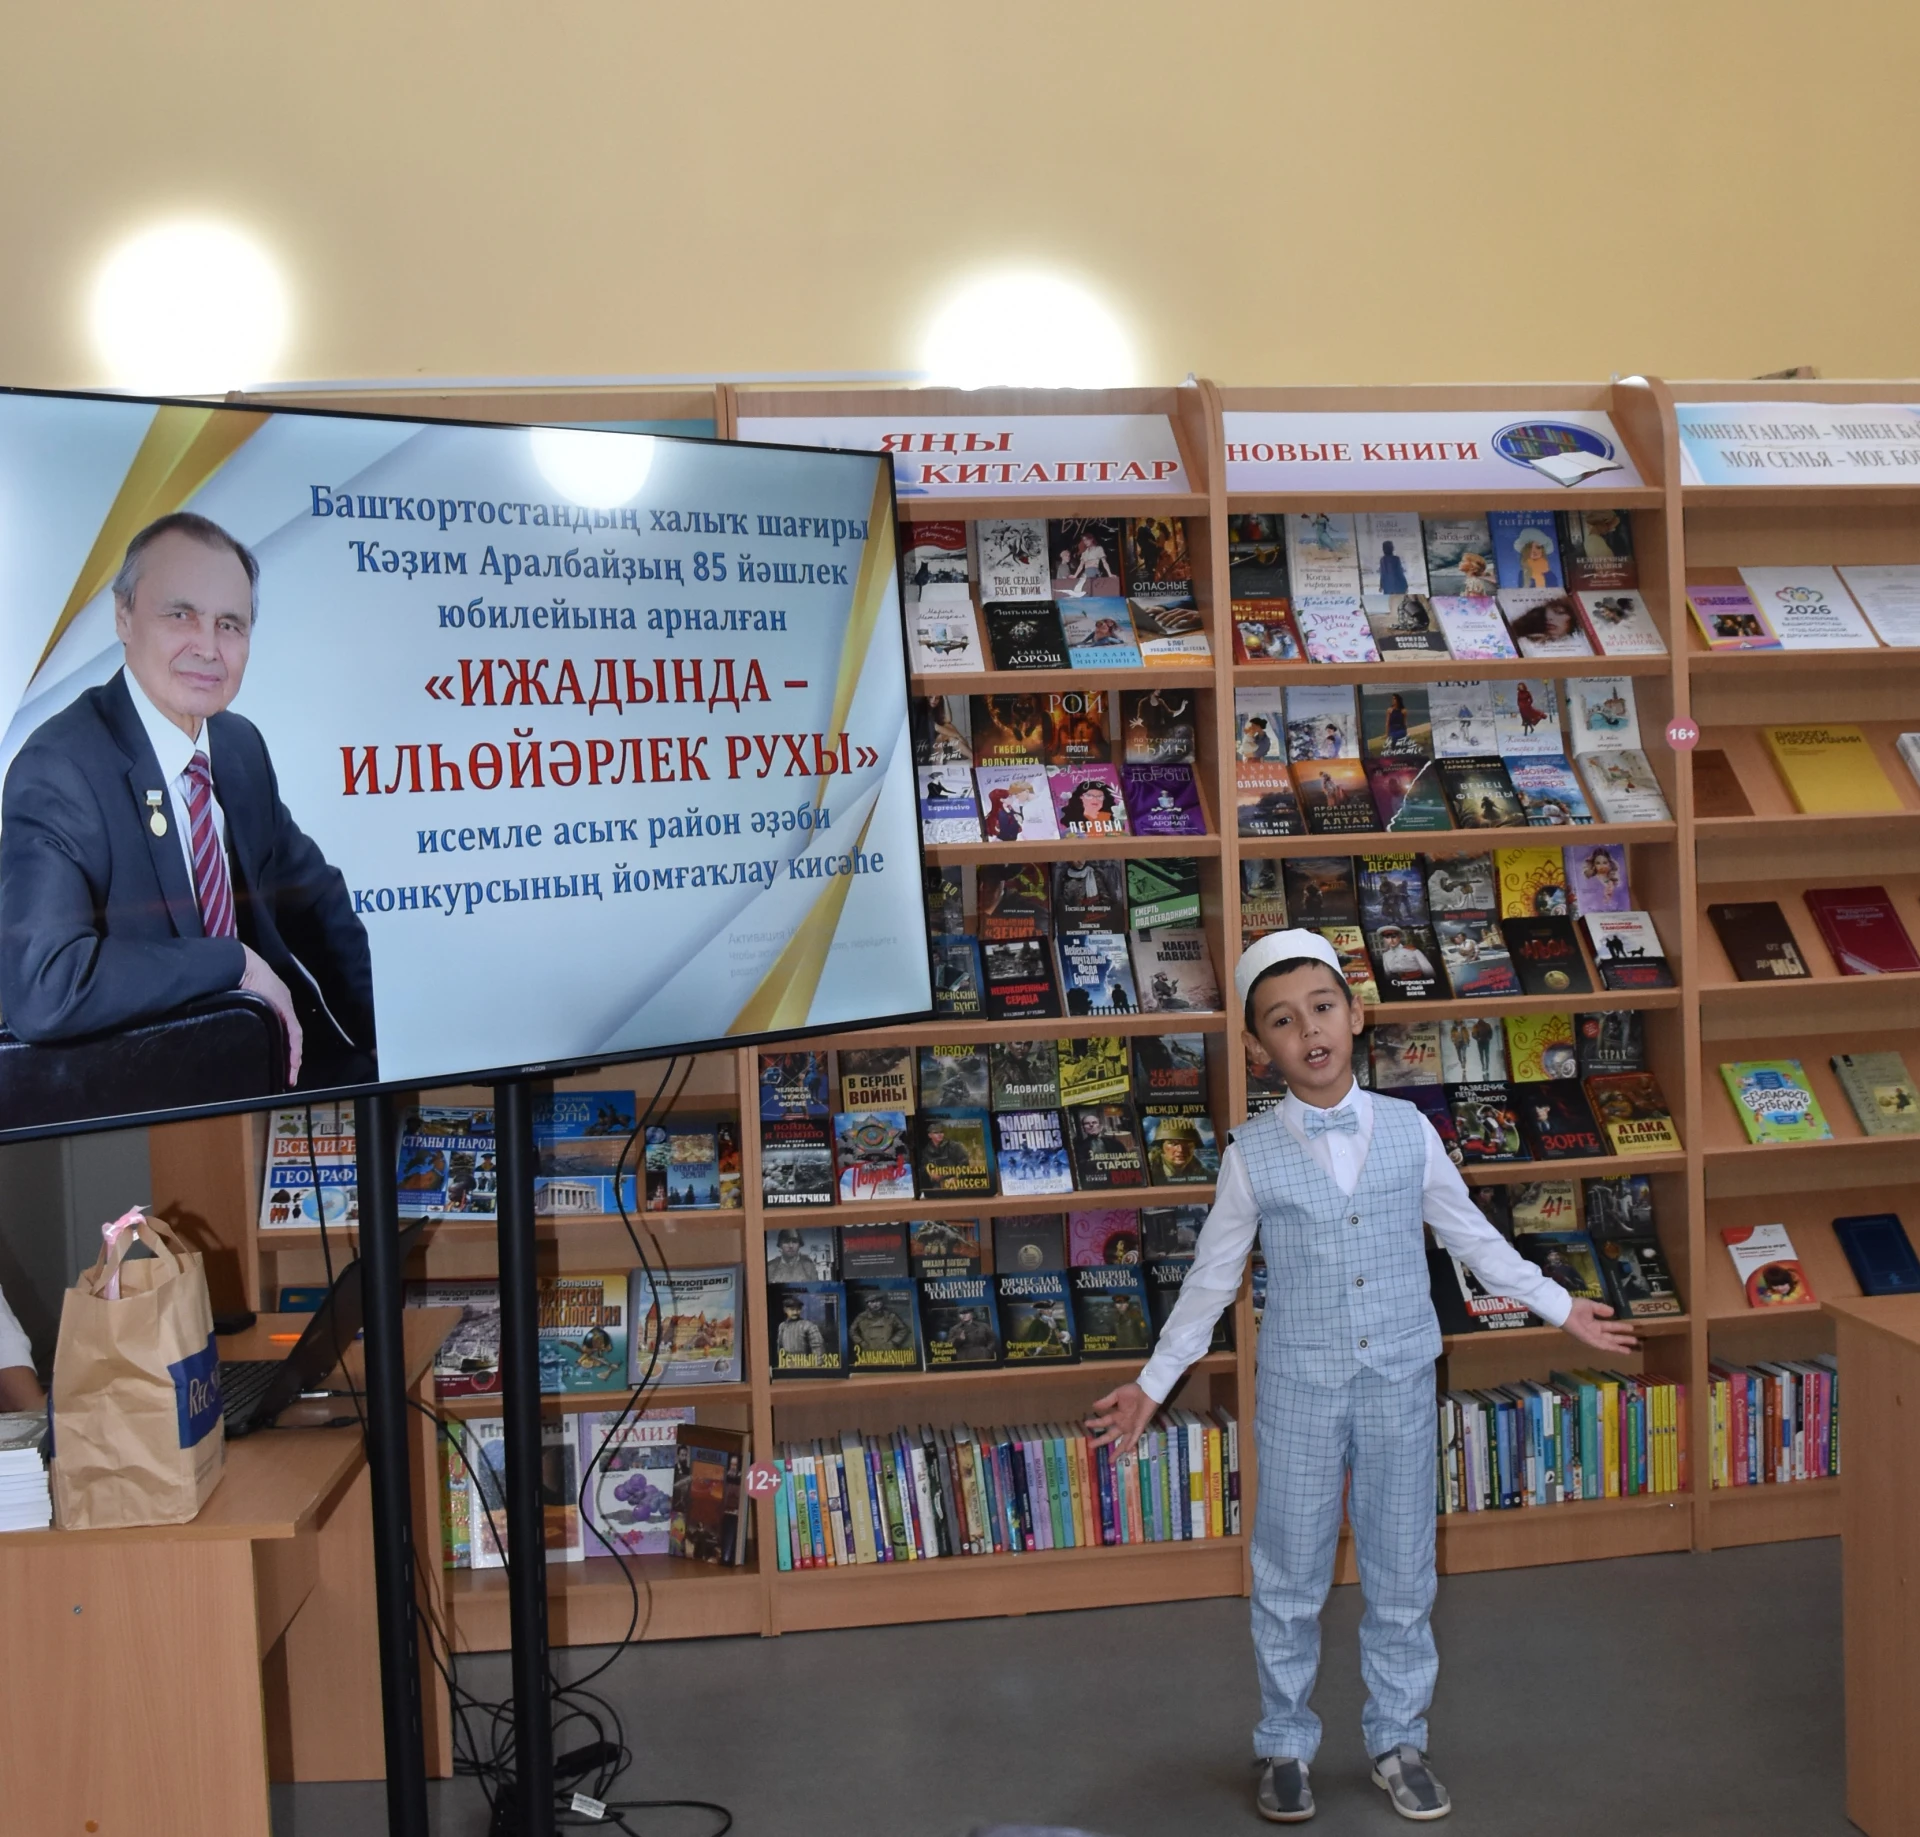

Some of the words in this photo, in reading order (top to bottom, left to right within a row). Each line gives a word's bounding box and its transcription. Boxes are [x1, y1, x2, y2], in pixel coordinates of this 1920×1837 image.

[879, 433, 1014, 455] ЯҢЫ
[1225, 444, 1351, 462] НОВЫЕ
[1363, 443, 1480, 461] КНИГИ
[1721, 451, 1764, 468] МОЯ
[1767, 452, 1834, 468] СЕМЬЯ
[1846, 451, 1892, 467] МОЕ
[919, 461, 1178, 484] КИТАПТАР
[310, 485, 640, 535] Башҡортостандың
[650, 509, 748, 537] халыҡ
[758, 512, 869, 545] шағиры
[350, 541, 468, 579] Ҡәҙим
[480, 544, 684, 586] Аралбайҙың
[694, 552, 727, 582] 85
[738, 557, 848, 586] йәшлек
[994, 576, 1011, 585] ТВОЕ
[1133, 581, 1188, 591] ОПАСНЫЕ
[995, 586, 1017, 596] БУДЕТ
[1784, 605, 1831, 614] 2026
[438, 598, 636, 631] юбилейына
[647, 605, 787, 637] арналған
[1008, 654, 1061, 665] ДОРОШ
[425, 659, 771, 716] «ИЖАДЫНДА
[1049, 690, 1104, 714] РОЙ
[1669, 728, 1696, 740] 16+
[994, 745, 1026, 754] ГИБЕЛЬ
[340, 728, 709, 797] ИЛҺӨЙӘРЛЕК
[728, 733, 878, 780] РУХЫ»
[982, 758, 1039, 766] ВОЛЬТИЖЕРА
[1237, 780, 1289, 788] ОЛЯКОВЫ
[1460, 781, 1503, 790] ВЕНЕЦ
[1517, 779, 1566, 788] номера
[1069, 820, 1122, 833] ПЕРВЫЙ
[1322, 816, 1371, 826] АЛТАЯ
[417, 826, 542, 853] исемле
[554, 818, 637, 846] асыҡ
[649, 808, 741, 846] район
[751, 804, 831, 838] әҙәби
[1367, 861, 1412, 873] ДЕСАНТ
[355, 874, 602, 914] конкурсының
[613, 859, 779, 898] йомғаҡлау
[789, 845, 884, 880] кисәһе
[1135, 905, 1158, 917] СМЕРТЬ
[1135, 916, 1150, 926] ПОД
[1150, 906, 1198, 923] ПСЕВДОНИМОМ
[1241, 913, 1284, 926] АЛАЧИ
[728, 930, 784, 944] Активация
[1157, 951, 1202, 961] КАВКАЗ
[1078, 965, 1098, 974] Федя
[1074, 974, 1099, 987] Булкин
[1005, 994, 1039, 1006] СЕРДЦА
[933, 1046, 975, 1057] ВОЗДУХ
[1402, 1042, 1427, 1064] 41
[1599, 1050, 1627, 1059] СТРАХ
[848, 1078, 855, 1089] В
[861, 1074, 905, 1088] СЕРДЦЕ
[1459, 1083, 1505, 1091] РАЗВЕДЧИК
[1005, 1083, 1056, 1095] Ядовитое
[849, 1088, 907, 1105] ВОЙНЫ
[1468, 1095, 1507, 1103] ВЕЛИКОГО
[1742, 1090, 1809, 1108] БЕЗОПАСНОСТЬ
[1146, 1105, 1179, 1115] МЕЖДУ
[1183, 1104, 1206, 1114] ДВУХ
[1618, 1121, 1666, 1135] АТАКА
[402, 1135, 445, 1147] СТРАНЫ
[448, 1137, 456, 1147] И
[1000, 1128, 1063, 1150] СПЕЦНАЗ
[1542, 1132, 1599, 1150] ЗОРГЕ
[1618, 1132, 1672, 1144] ВСЛЕПУЮ
[1089, 1150, 1138, 1161] ЗАВЕЩАНИЕ
[926, 1163, 986, 1176] Сибирская
[1096, 1160, 1140, 1170] СТАРОГО
[944, 1177, 988, 1190] одиссея
[767, 1193, 831, 1204] ПУЛЕМЕТЧИКИ
[1540, 1196, 1563, 1218] 41
[924, 1281, 986, 1292] ВЛАДИМИР
[1001, 1276, 1059, 1287] ВЯЧЕСЛАВ
[929, 1289, 984, 1300] ТОПИЛИН
[1000, 1285, 1062, 1296] СОФРОНОВ
[821, 1354, 840, 1367] зов
[600, 1427, 678, 1444] ХИМИЯ
[745, 1470, 782, 1490] 12+
